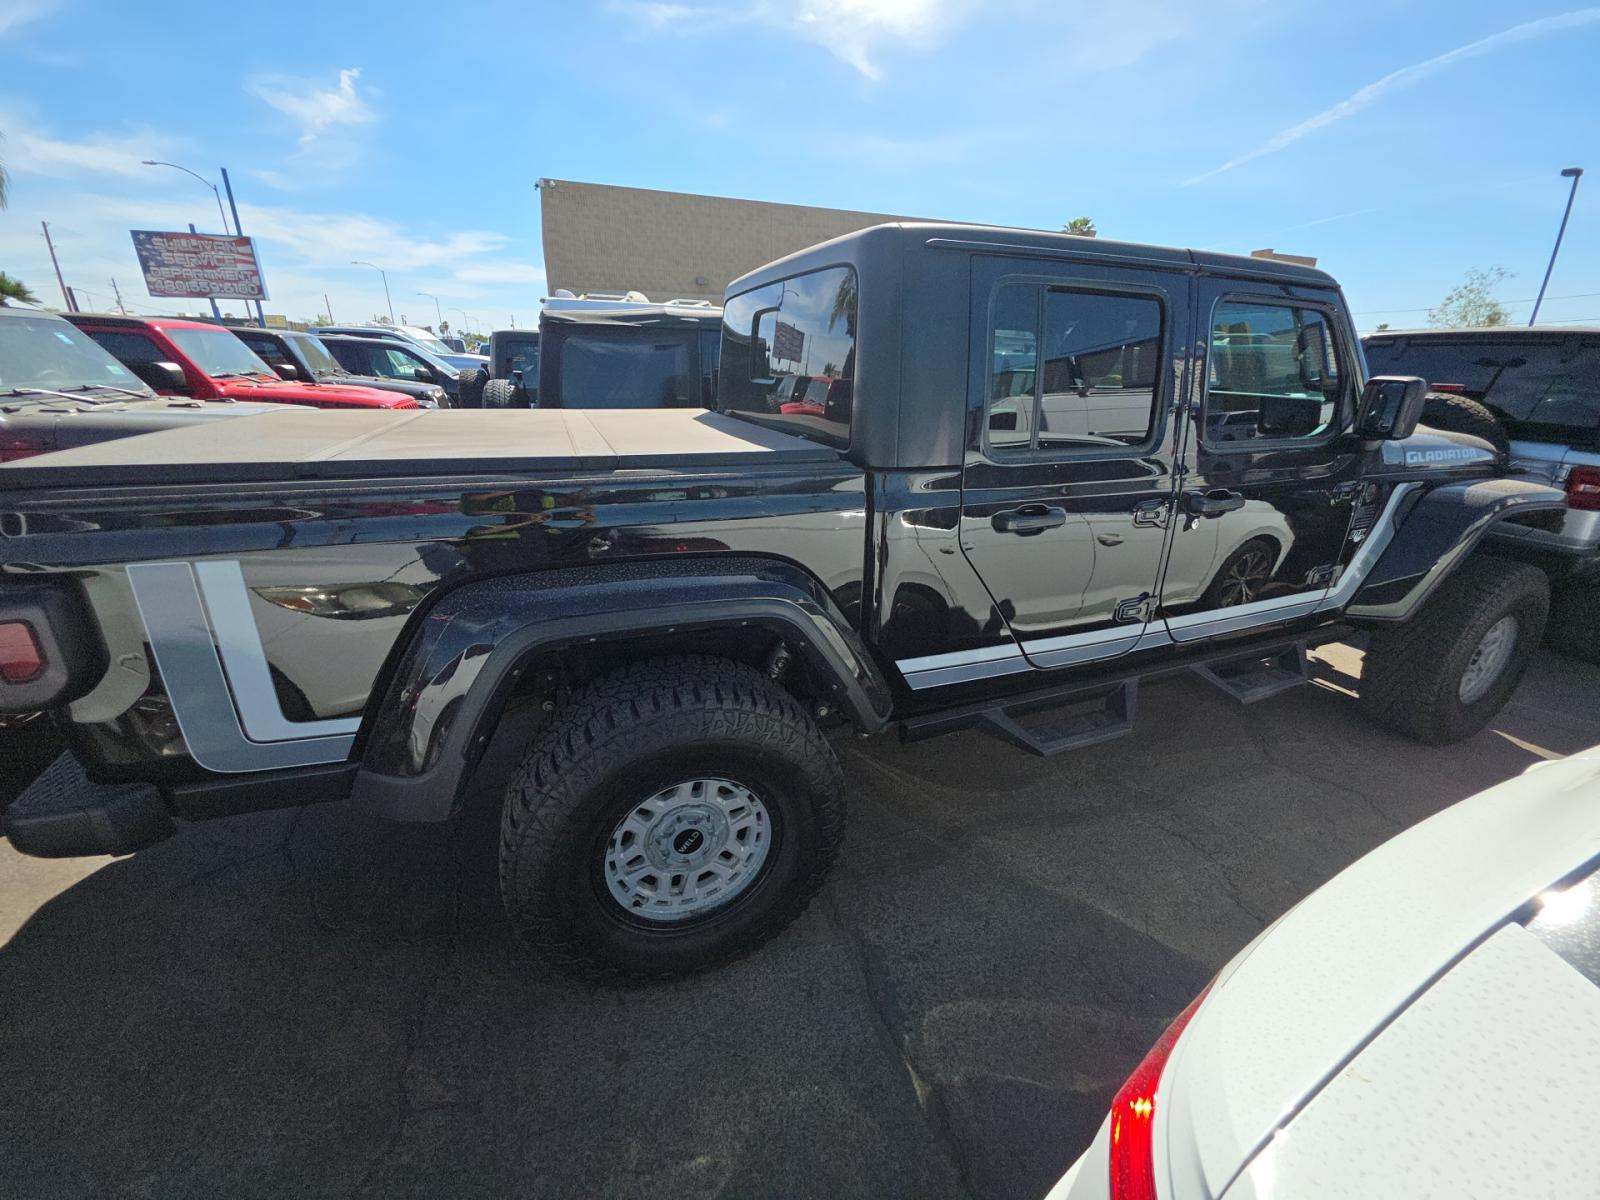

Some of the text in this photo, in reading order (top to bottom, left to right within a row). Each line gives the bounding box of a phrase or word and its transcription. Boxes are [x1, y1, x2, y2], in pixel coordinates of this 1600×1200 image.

[161, 252, 238, 267] SERVICE
[150, 266, 253, 281] DEPARTMENT
[1406, 449, 1478, 463] GLADIATOR
[678, 831, 700, 852] WELD
